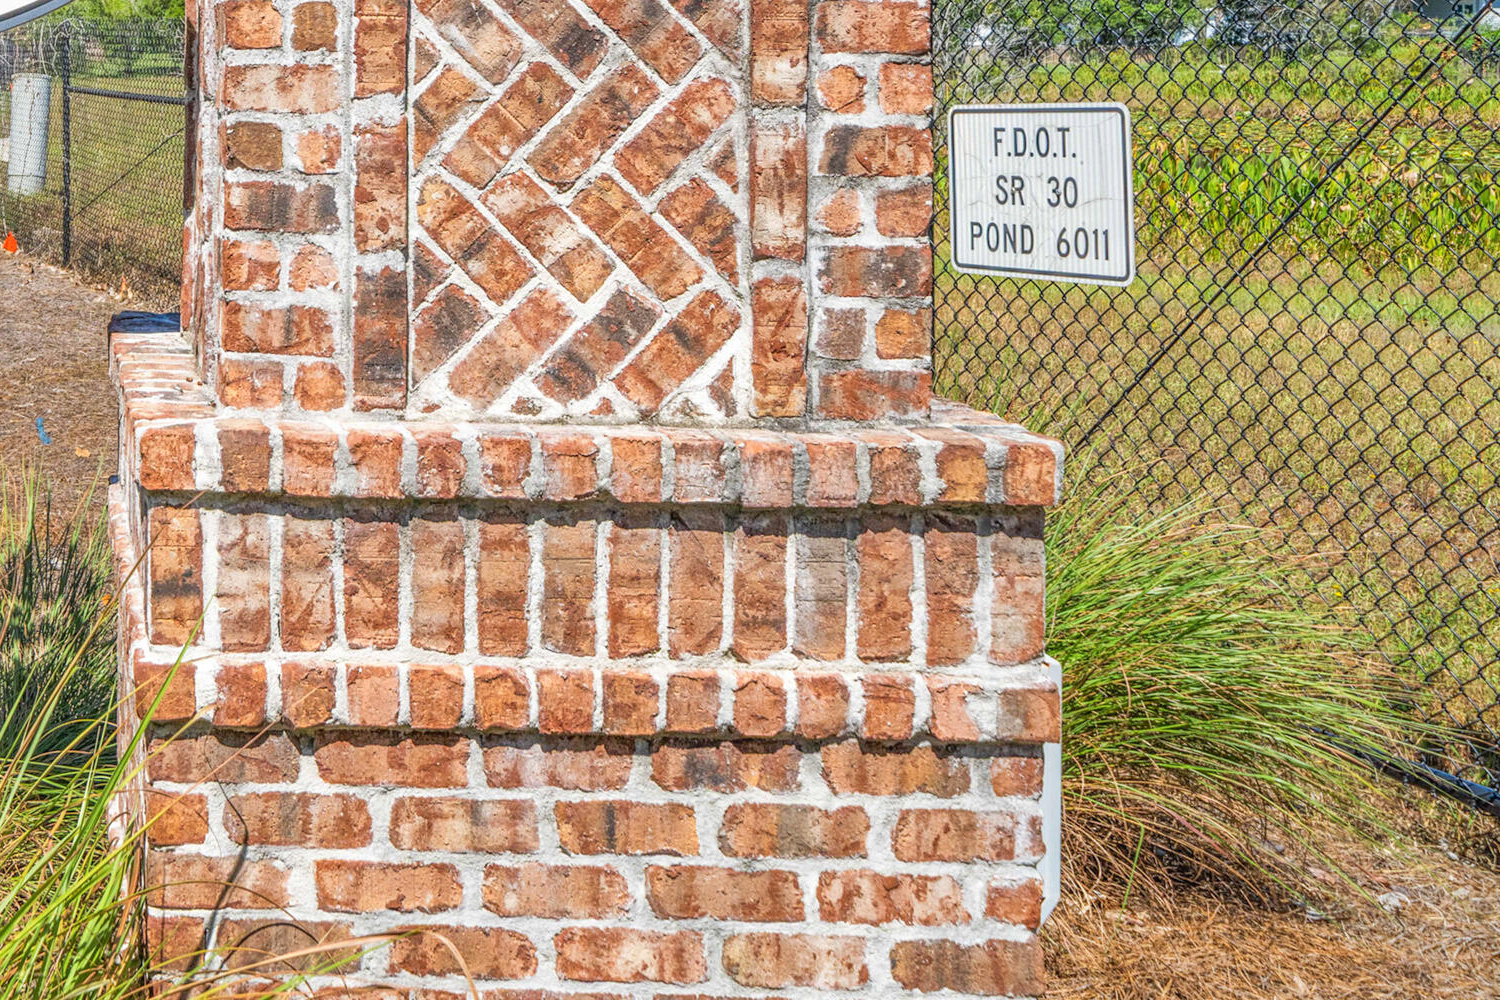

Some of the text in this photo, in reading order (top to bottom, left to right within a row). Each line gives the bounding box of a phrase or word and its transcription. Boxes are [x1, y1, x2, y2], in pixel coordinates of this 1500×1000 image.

[993, 127, 1077, 158] F.D.O.T.
[995, 175, 1078, 208] SR 30
[970, 221, 1109, 260] POND 6011
